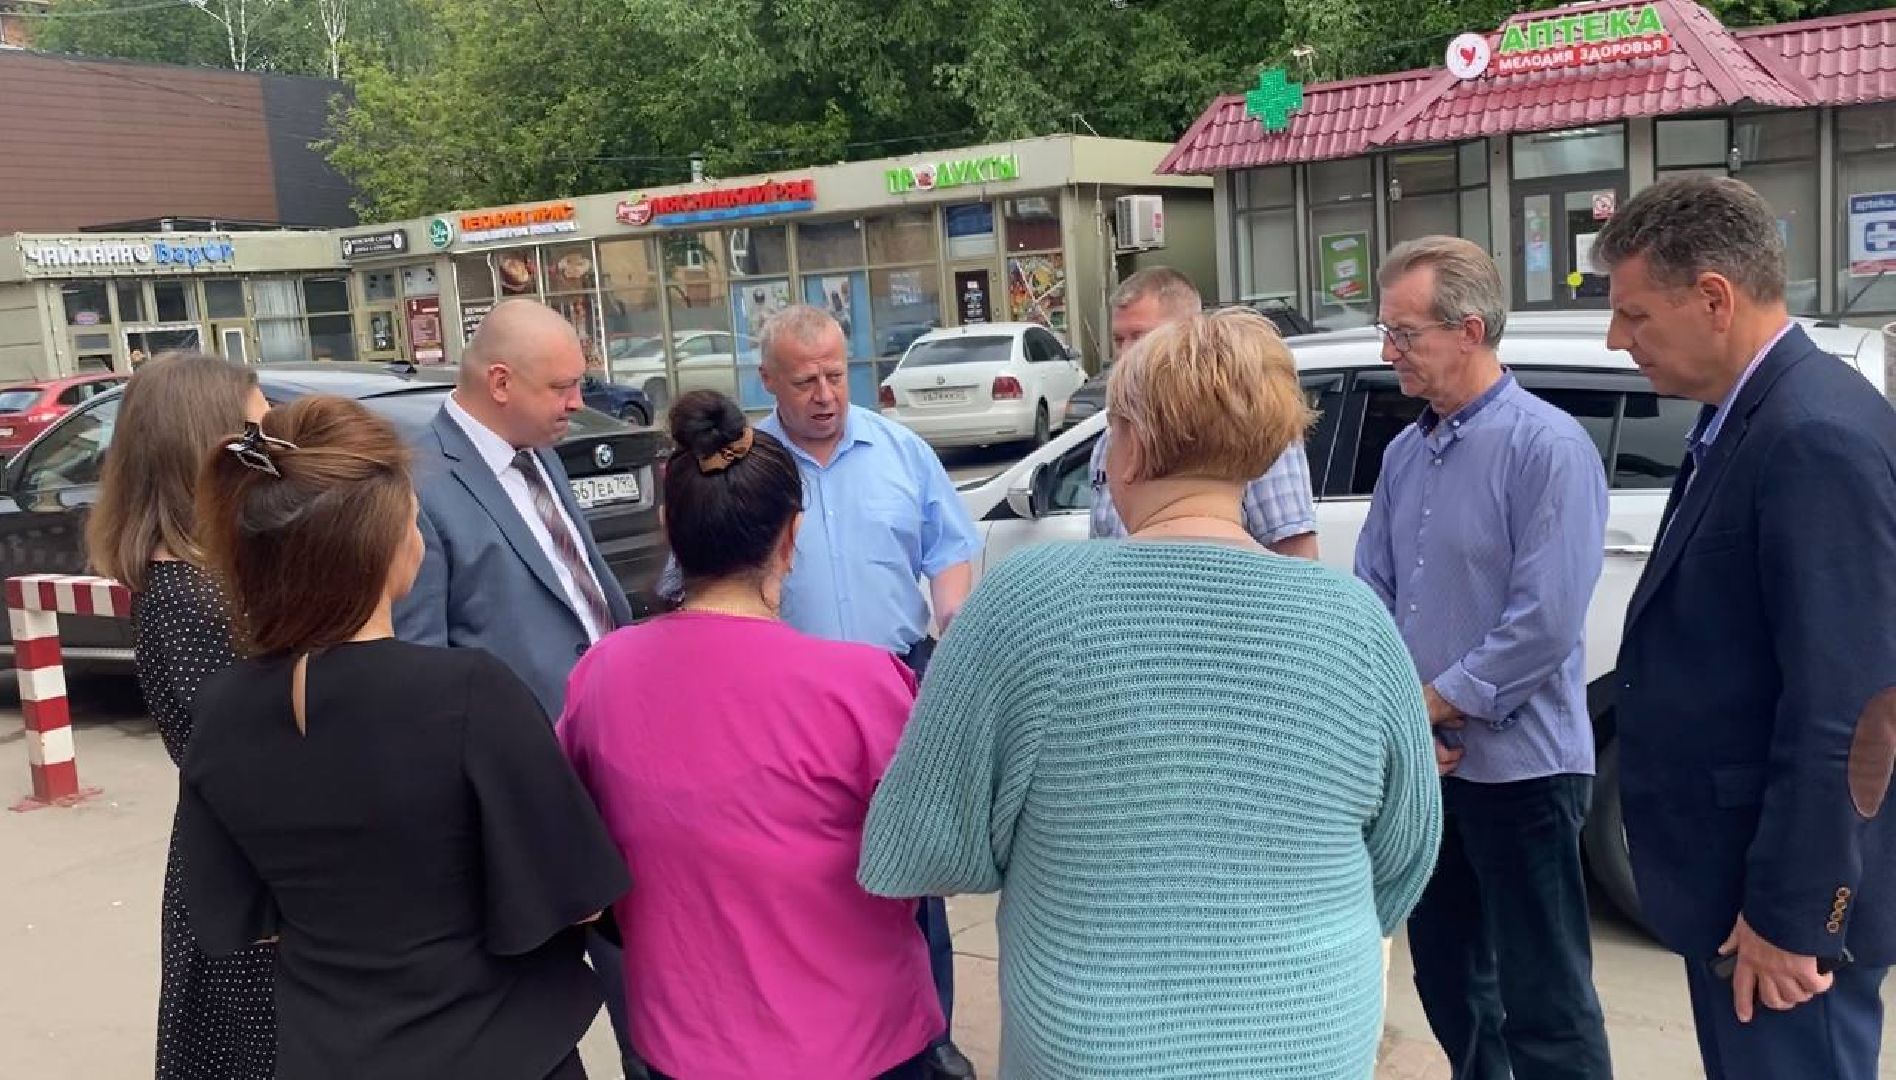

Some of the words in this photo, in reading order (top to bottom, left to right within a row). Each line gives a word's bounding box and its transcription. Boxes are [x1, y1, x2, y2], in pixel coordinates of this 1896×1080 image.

[1502, 6, 1662, 53] АПТЕКА
[1501, 49, 1574, 71] МЕЛОДИЯ
[1580, 40, 1663, 61] ЗДОРОВЬЯ
[885, 154, 1020, 194] ПРОДУКТЫ
[24, 241, 134, 266] ЧАЙХАНА
